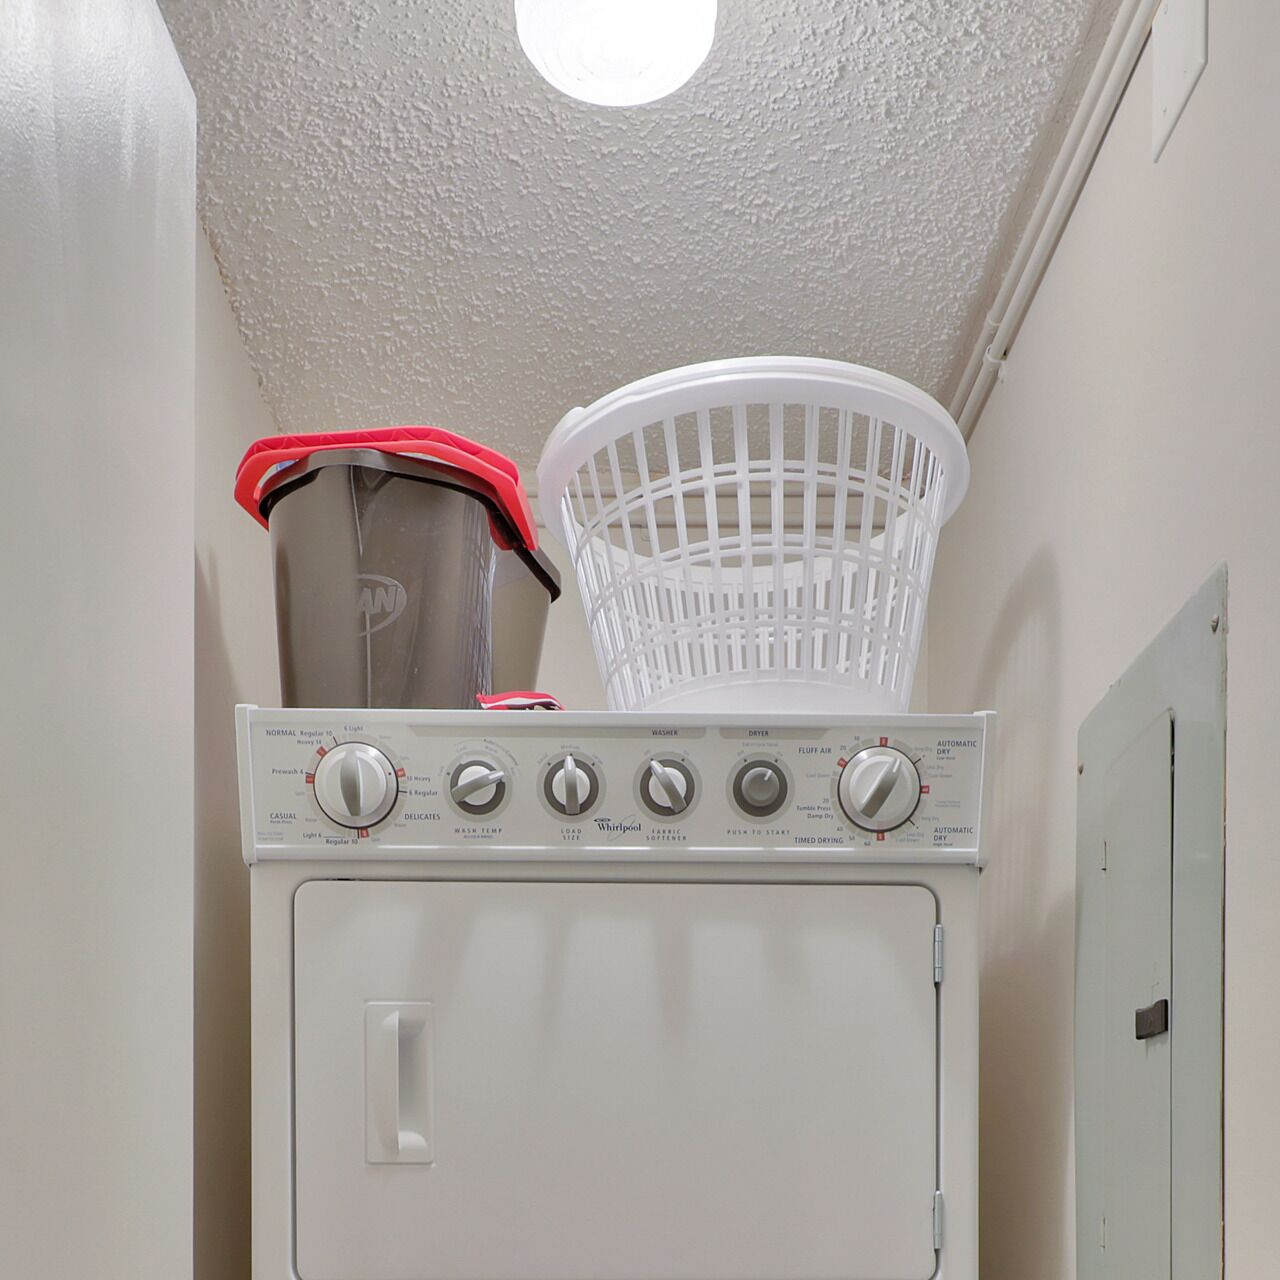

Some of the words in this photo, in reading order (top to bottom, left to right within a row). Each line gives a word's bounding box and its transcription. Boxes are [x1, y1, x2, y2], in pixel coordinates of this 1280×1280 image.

[300, 730, 324, 738] Regular
[937, 740, 977, 748] AUTOMATIC
[597, 823, 641, 834] Whirlpool
[934, 826, 973, 834] AUTOMATIC
